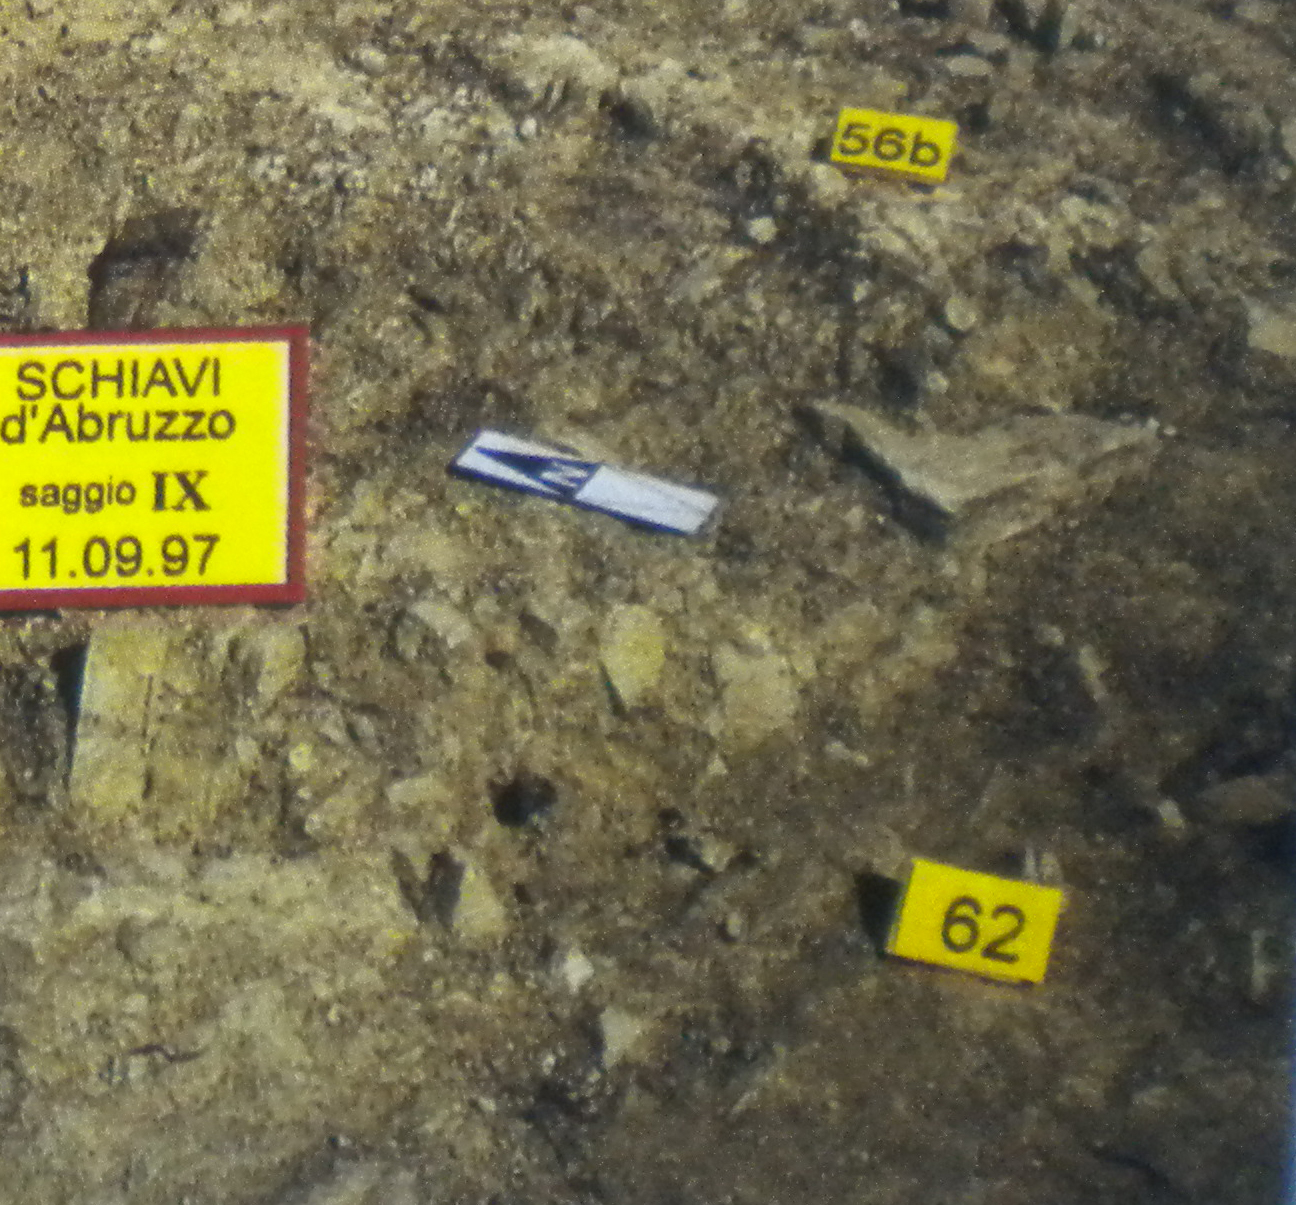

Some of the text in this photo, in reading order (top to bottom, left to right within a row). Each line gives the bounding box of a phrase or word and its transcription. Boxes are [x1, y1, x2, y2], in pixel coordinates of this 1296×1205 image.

[838, 122, 941, 166] 56b
[16, 357, 221, 402] SCHIAVI
[0, 402, 235, 444] d'Abruzzo
[19, 470, 211, 514] saggio IX
[13, 534, 221, 580] 11.09.97
[941, 896, 1025, 964] 62
